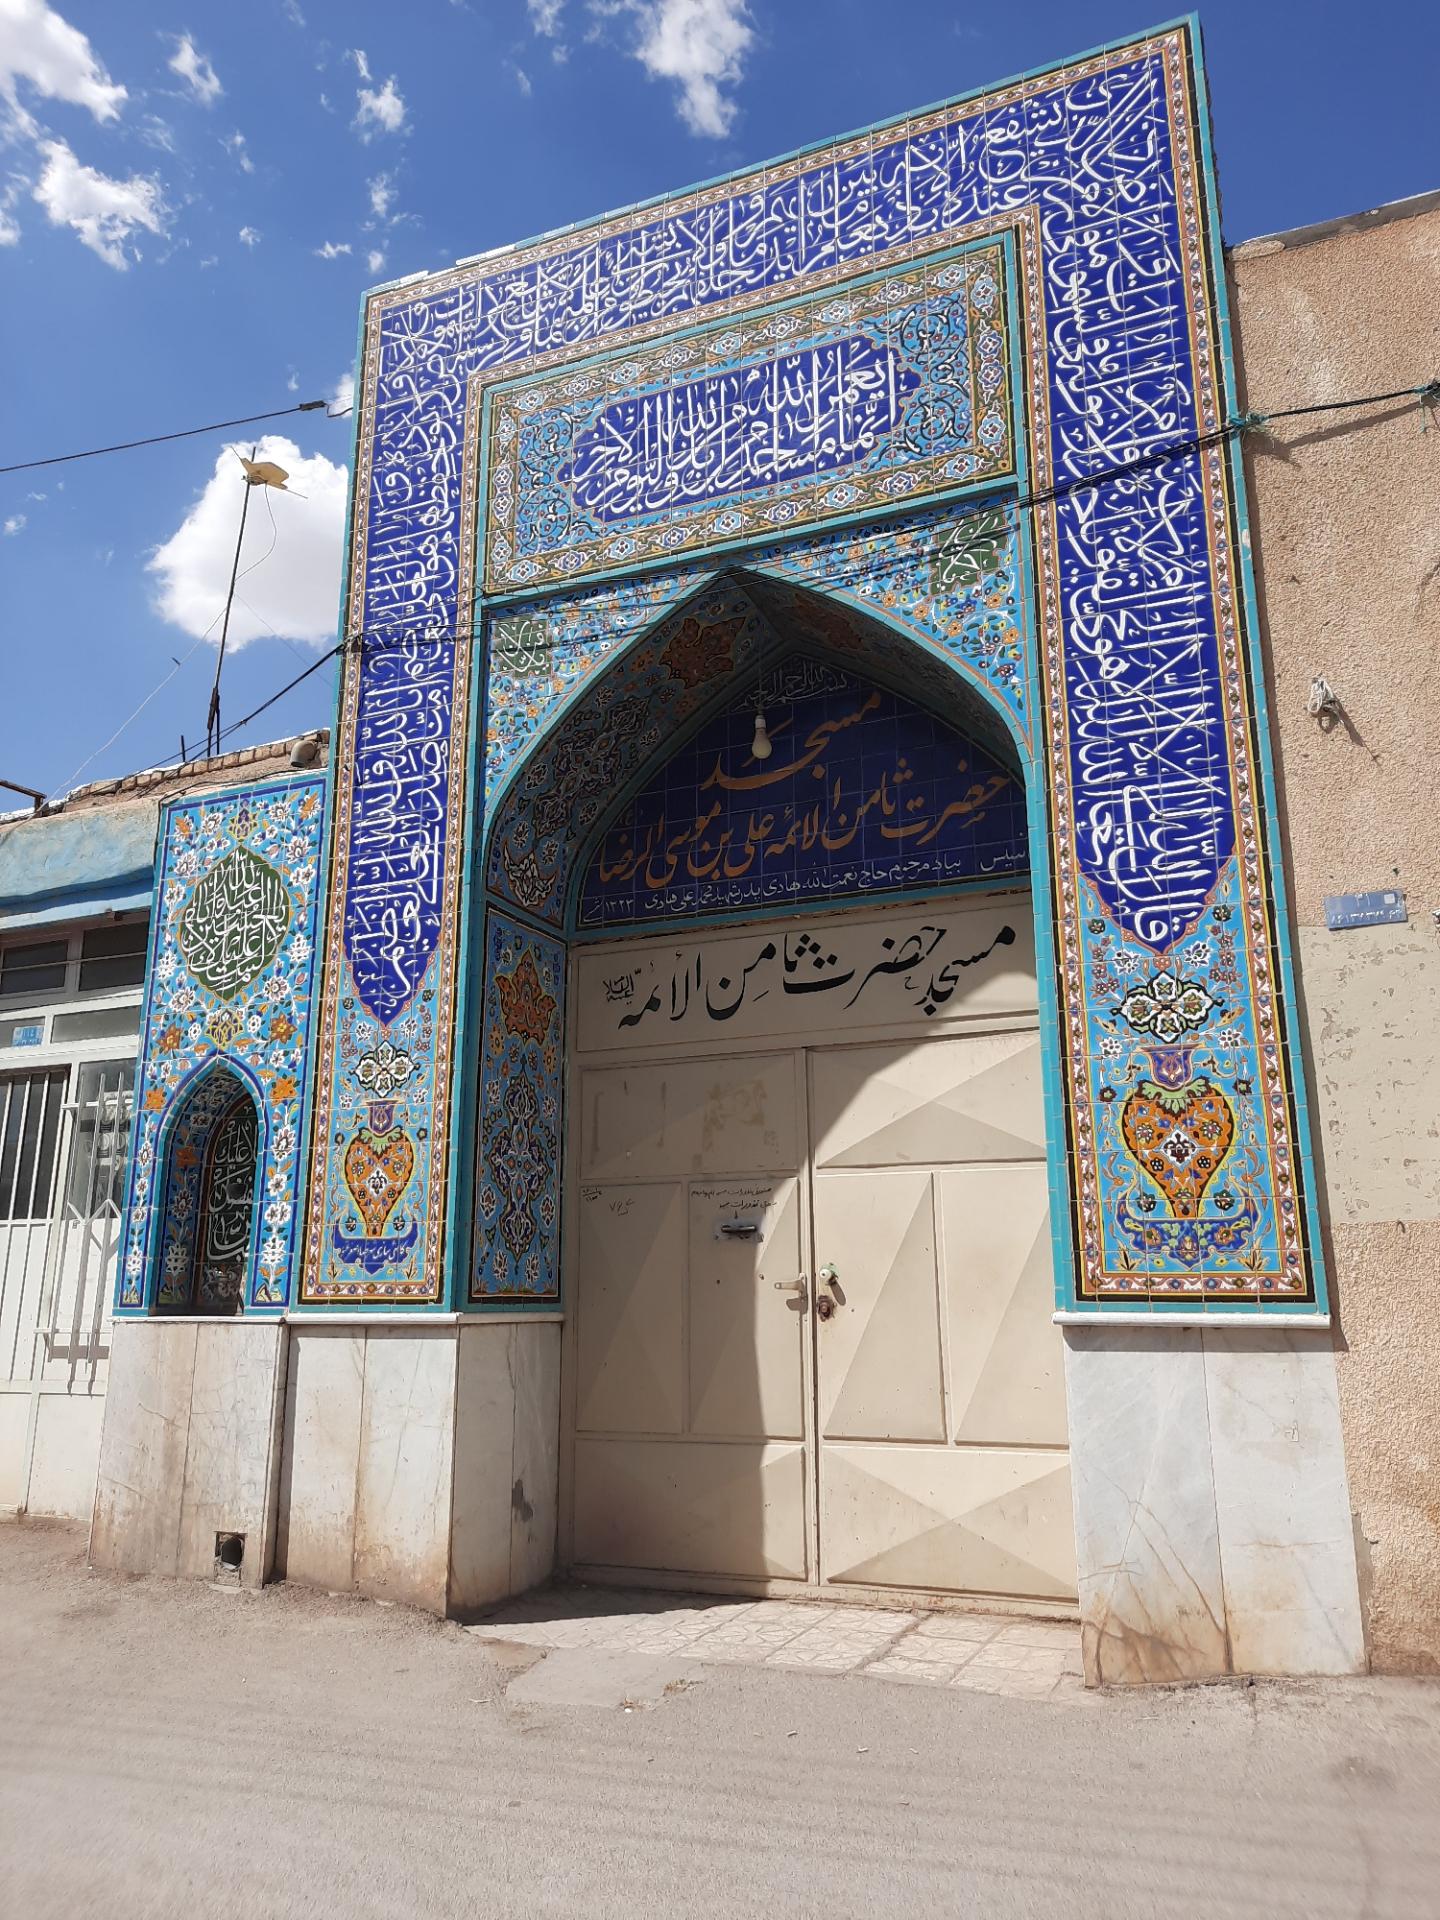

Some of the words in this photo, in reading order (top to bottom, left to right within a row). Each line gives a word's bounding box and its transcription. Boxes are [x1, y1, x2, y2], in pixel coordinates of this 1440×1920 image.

[700, 691, 881, 791] مسجد
[724, 812, 775, 878] علی
[821, 757, 914, 850] ثامن
[880, 758, 1011, 846] حضرت
[688, 827, 734, 881] بن
[705, 933, 821, 1021] ثامن
[783, 925, 948, 1010] حضرت
[914, 925, 1016, 1016] مسجد
